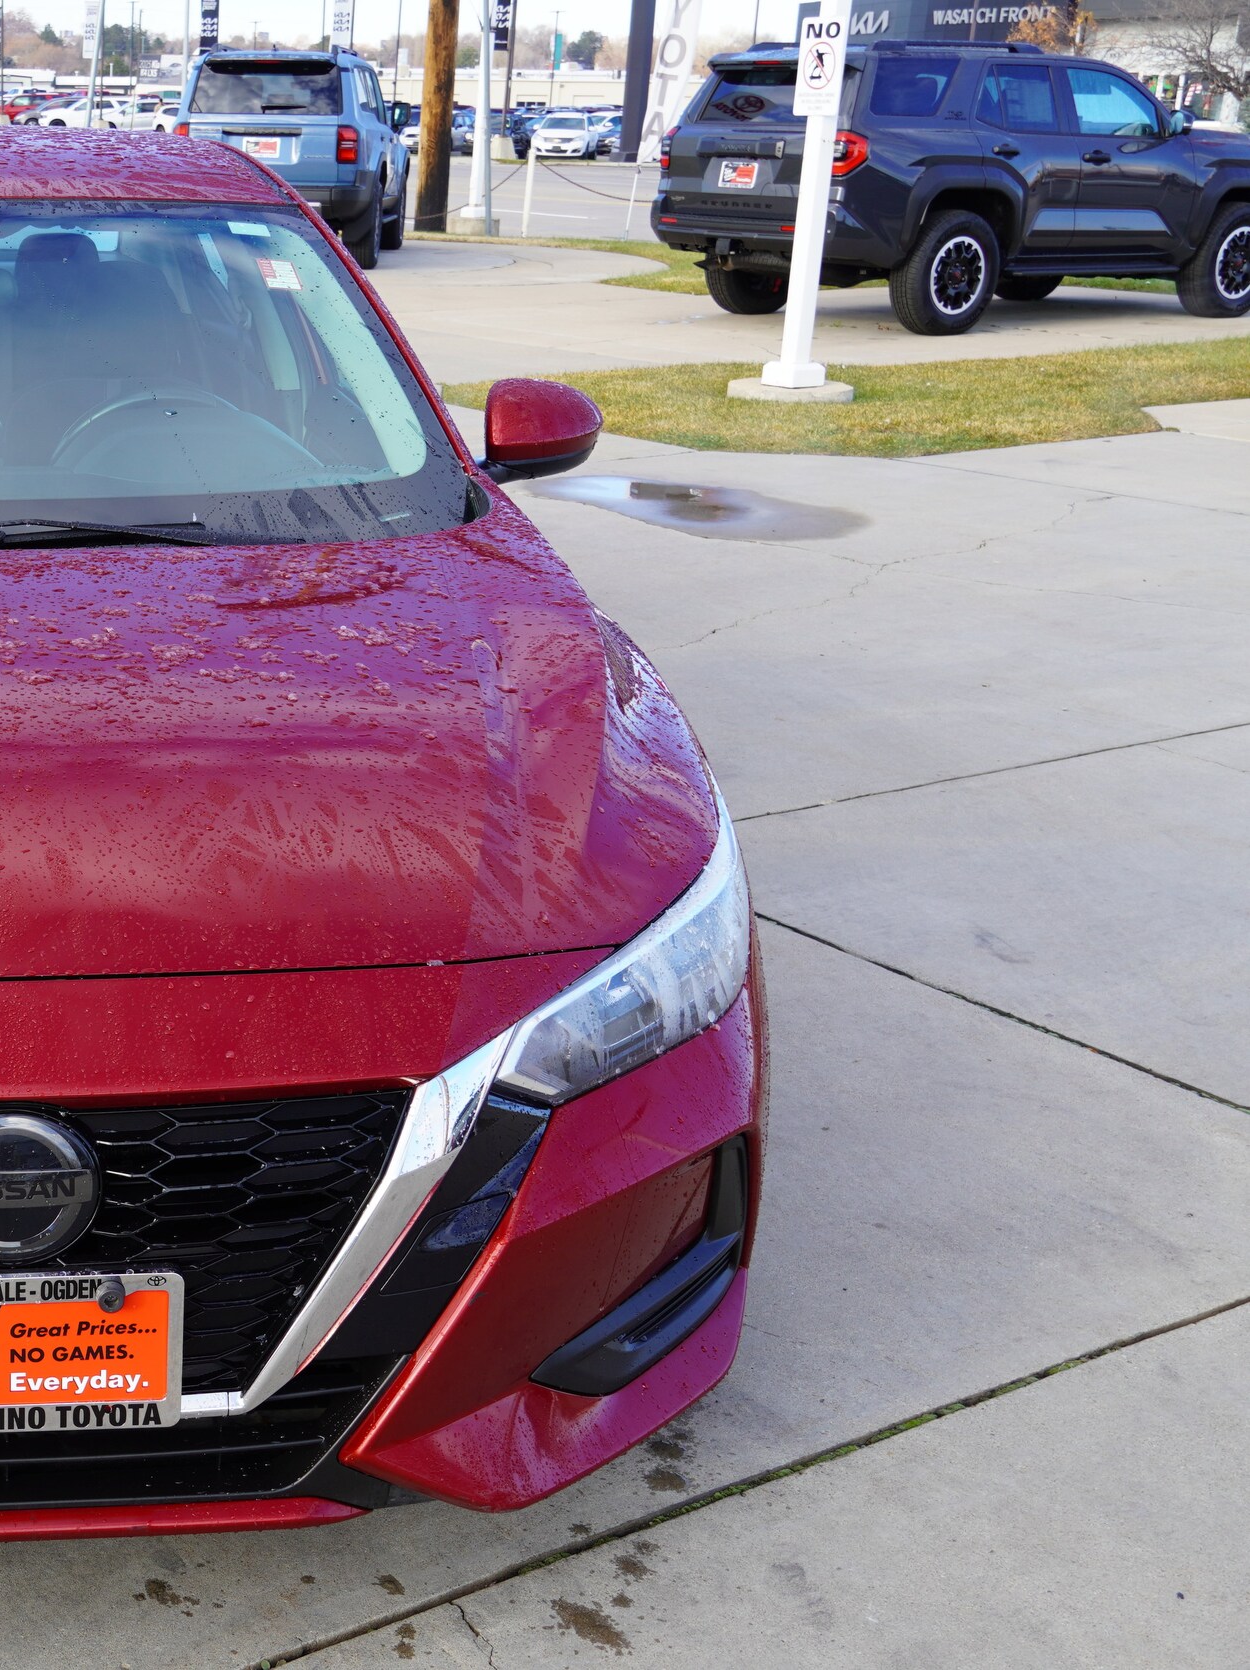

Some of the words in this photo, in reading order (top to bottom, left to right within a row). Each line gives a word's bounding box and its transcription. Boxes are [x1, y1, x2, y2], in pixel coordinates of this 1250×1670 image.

[933, 7, 997, 25] WASATCH
[806, 21, 841, 39] NO
[41, 1278, 102, 1301] OGDEN
[9, 1322, 71, 1339] Great
[77, 1319, 158, 1336] Prices...
[9, 1347, 45, 1363] NO
[51, 1344, 135, 1361] GAMES.
[9, 1369, 150, 1395] Everyday.
[55, 1402, 162, 1428] TOYOTA
